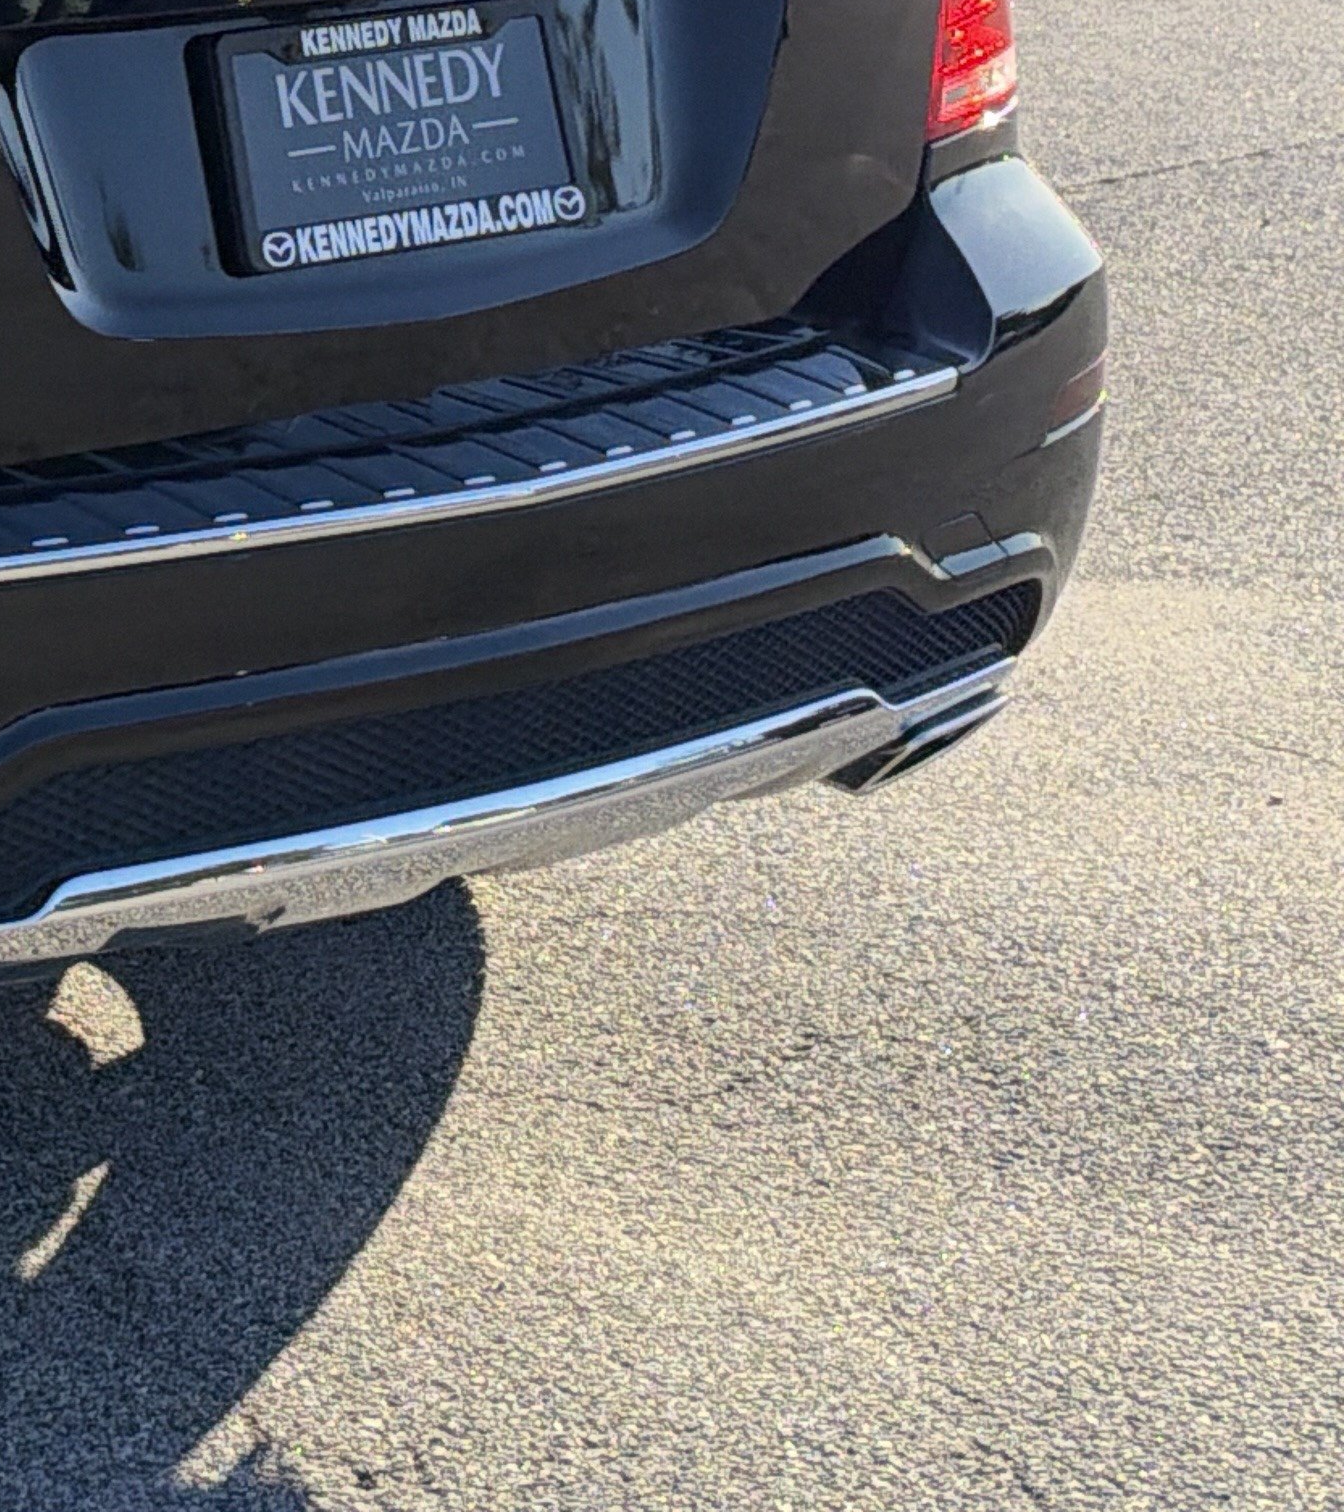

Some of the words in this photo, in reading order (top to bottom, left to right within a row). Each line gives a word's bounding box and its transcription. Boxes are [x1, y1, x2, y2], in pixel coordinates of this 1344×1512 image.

[299, 16, 403, 58] KENNEDY
[406, 7, 484, 44] MAZDA
[274, 42, 505, 130] KENNEDY
[342, 113, 470, 164] MAZDA
[294, 188, 556, 265] KENNEDYMAZDA.COM
